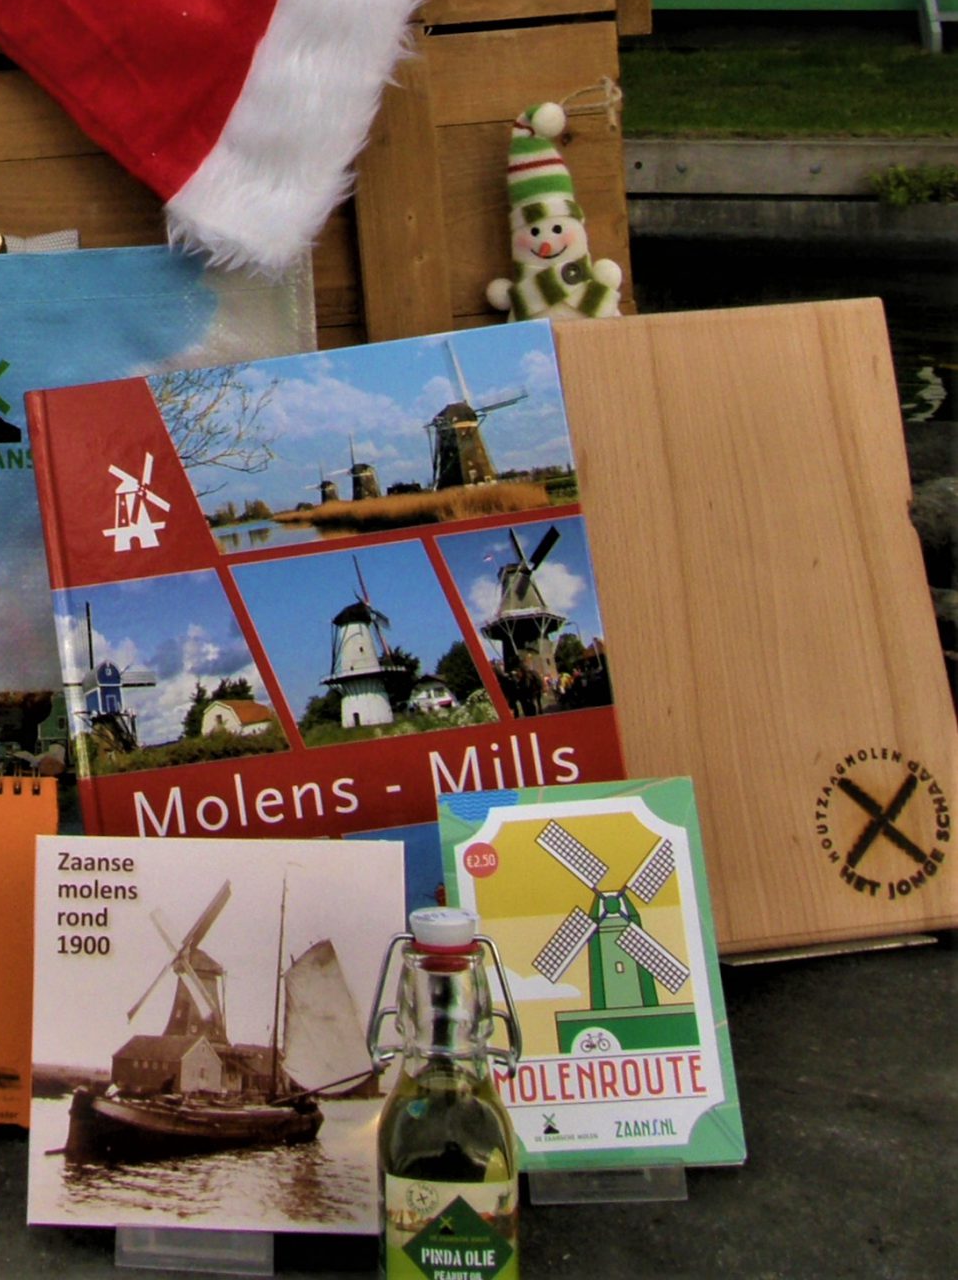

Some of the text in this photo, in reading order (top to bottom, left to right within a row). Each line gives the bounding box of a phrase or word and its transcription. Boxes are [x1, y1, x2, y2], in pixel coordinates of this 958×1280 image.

[133, 773, 359, 837] Molens
[428, 732, 580, 794] Mills
[57, 851, 135, 873] Zaanse
[466, 853, 497, 868] €2.50
[57, 878, 139, 900] molens
[57, 906, 109, 928] rond
[56, 934, 111, 956] 1900
[494, 1054, 707, 1103] MOLENROUTE
[421, 1247, 496, 1267] PINDA OLIE
